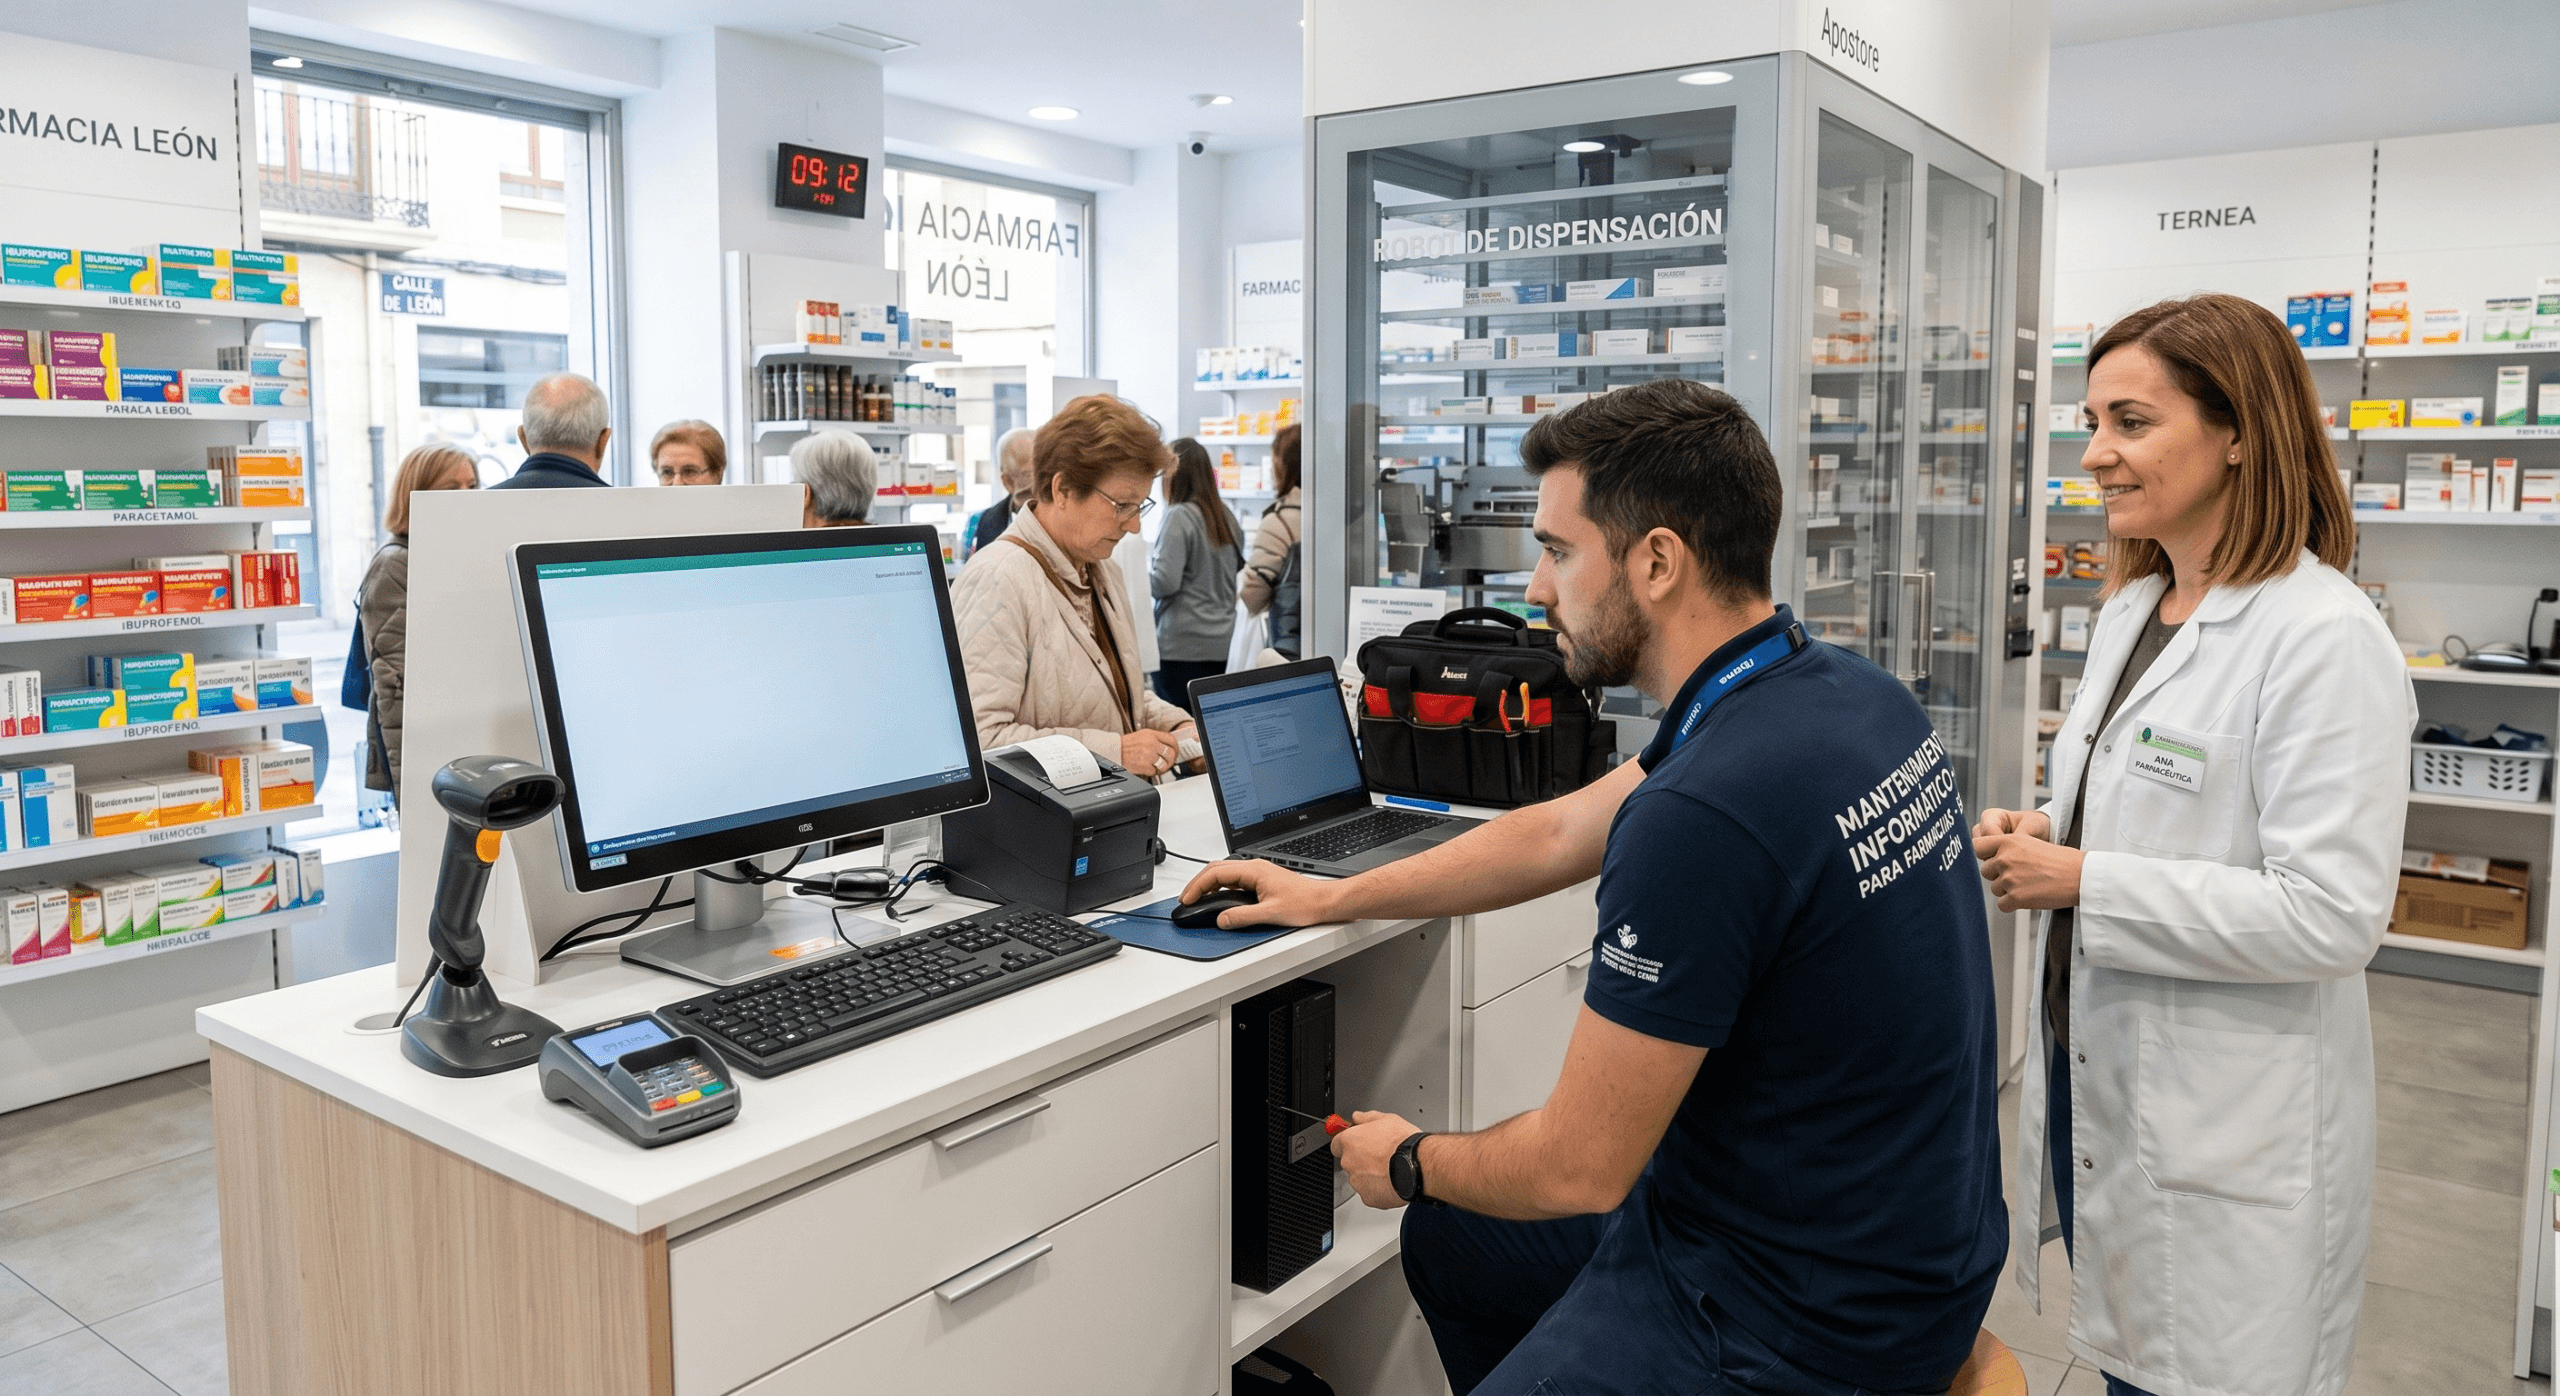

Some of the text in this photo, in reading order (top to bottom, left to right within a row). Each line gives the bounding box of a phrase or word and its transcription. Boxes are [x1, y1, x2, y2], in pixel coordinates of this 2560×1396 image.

[1821, 7, 1879, 73] Apostore
[133, 126, 217, 161] LEÓN
[791, 153, 859, 193] 09:12
[1374, 202, 1722, 262] ROBOT DE DISPENSACIÓN
[2157, 205, 2256, 231] TERNEA
[393, 275, 434, 294] CALLE
[1242, 279, 1301, 296] FARMAC
[384, 294, 444, 315] DE LEÓN
[113, 511, 199, 522] PARACETAMOL
[2154, 755, 2175, 768] ANA
[1848, 767, 1953, 874] INFORMÁTICO
[1858, 858, 1904, 899] PARA
